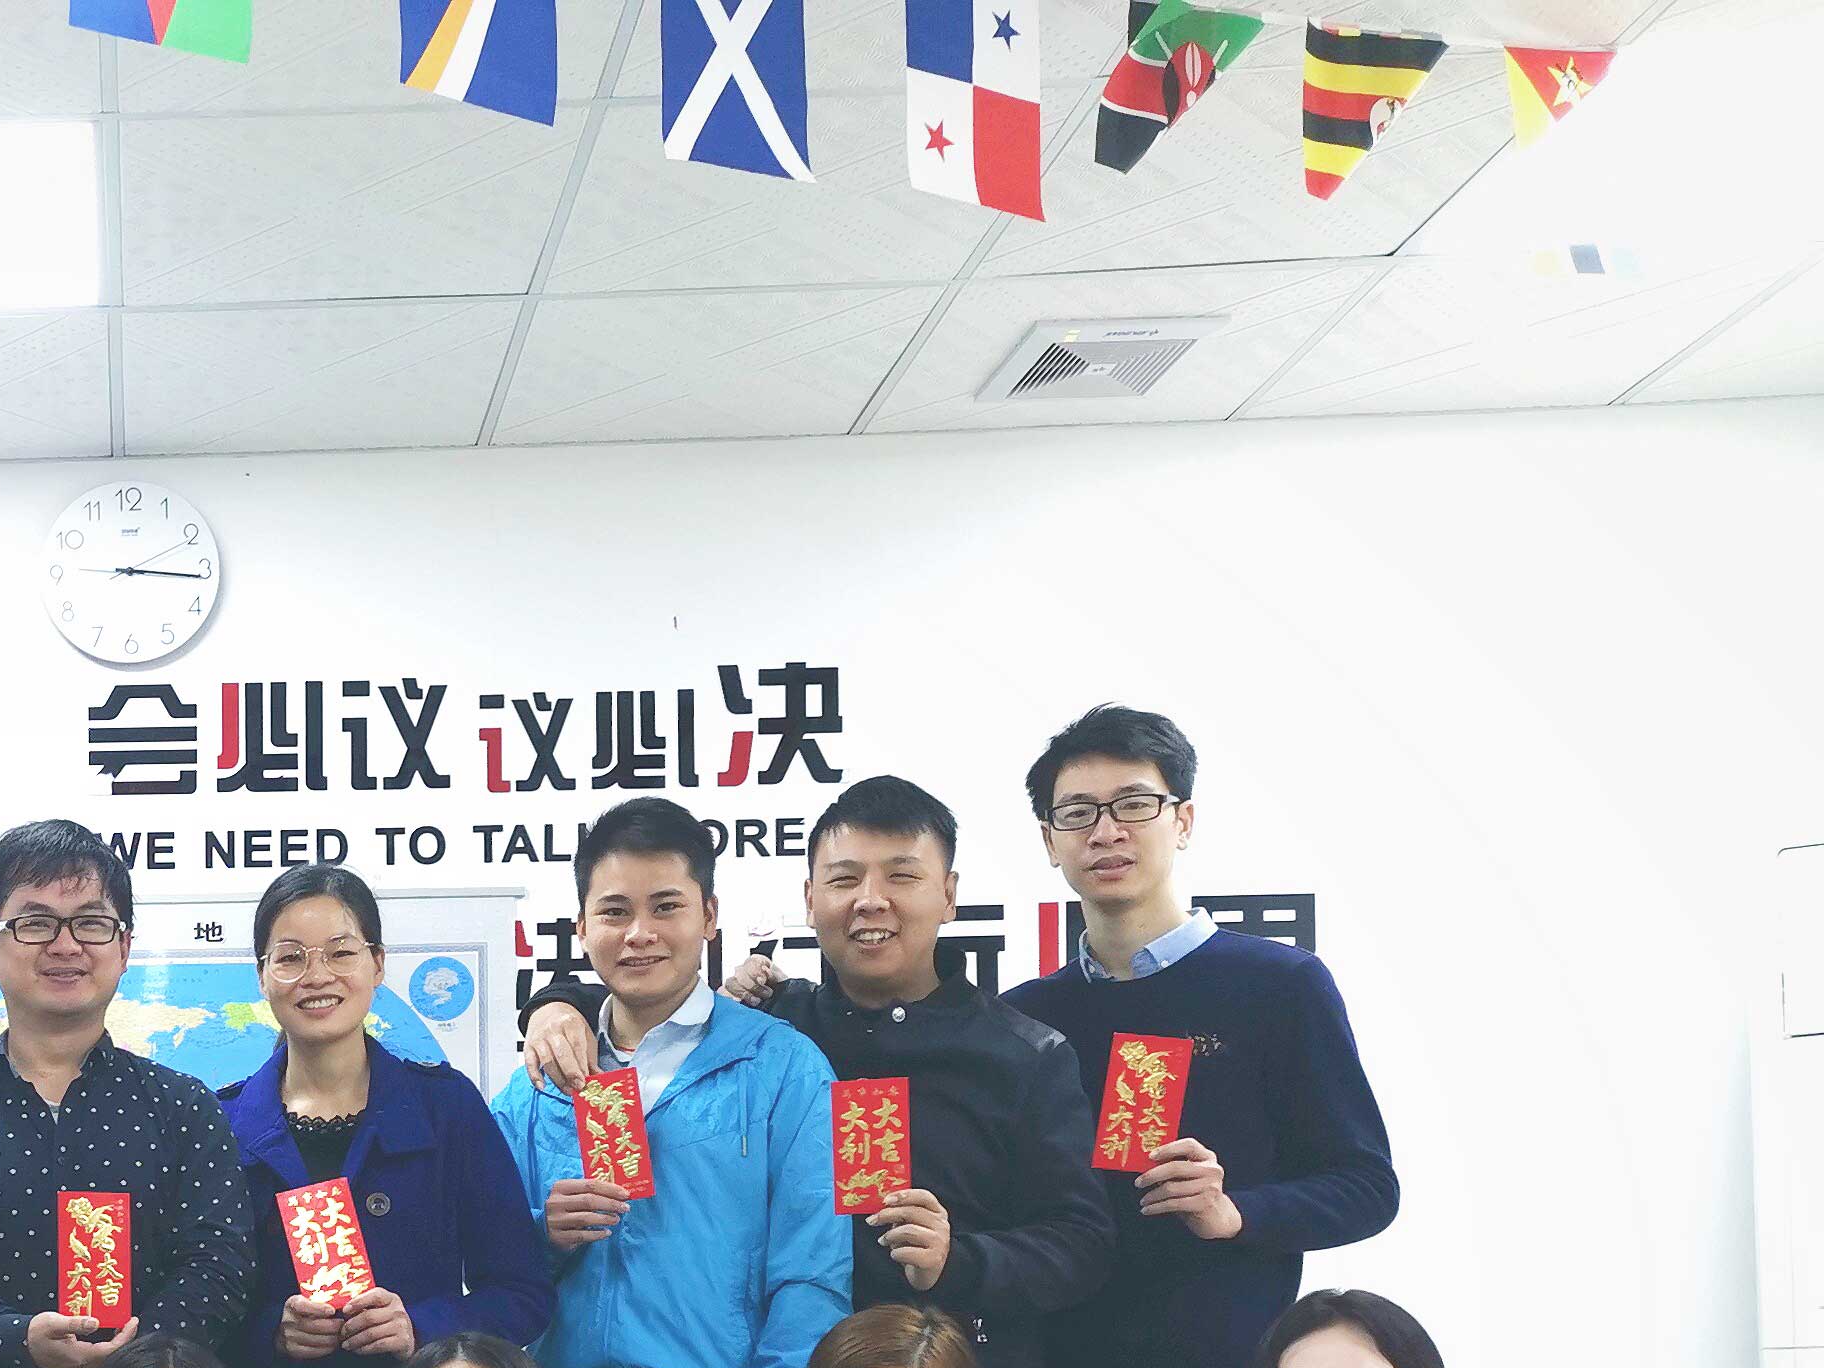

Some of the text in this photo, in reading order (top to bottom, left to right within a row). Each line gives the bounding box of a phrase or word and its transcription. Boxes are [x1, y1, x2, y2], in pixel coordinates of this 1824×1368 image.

[115, 487, 142, 512] 12
[160, 497, 169, 520] 1
[83, 501, 101, 521] 11
[56, 529, 84, 550] 10
[183, 523, 200, 545] 2
[50, 564, 64, 586] 9
[198, 558, 212, 580] 3
[61, 601, 75, 622] 8
[187, 596, 202, 616] 4
[91, 626, 104, 648] 7
[125, 633, 139, 655] 6
[161, 623, 175, 645] 5
[97, 818, 806, 870] WE NEED TO TAL ORE
[194, 921, 225, 942] 地
[838, 1100, 871, 1165] 大利
[872, 1097, 905, 1162] 大吉
[615, 1127, 642, 1178] 大吉
[289, 1206, 329, 1265] 大利
[320, 1197, 357, 1257] 大吉
[96, 1252, 124, 1306] 大吉
